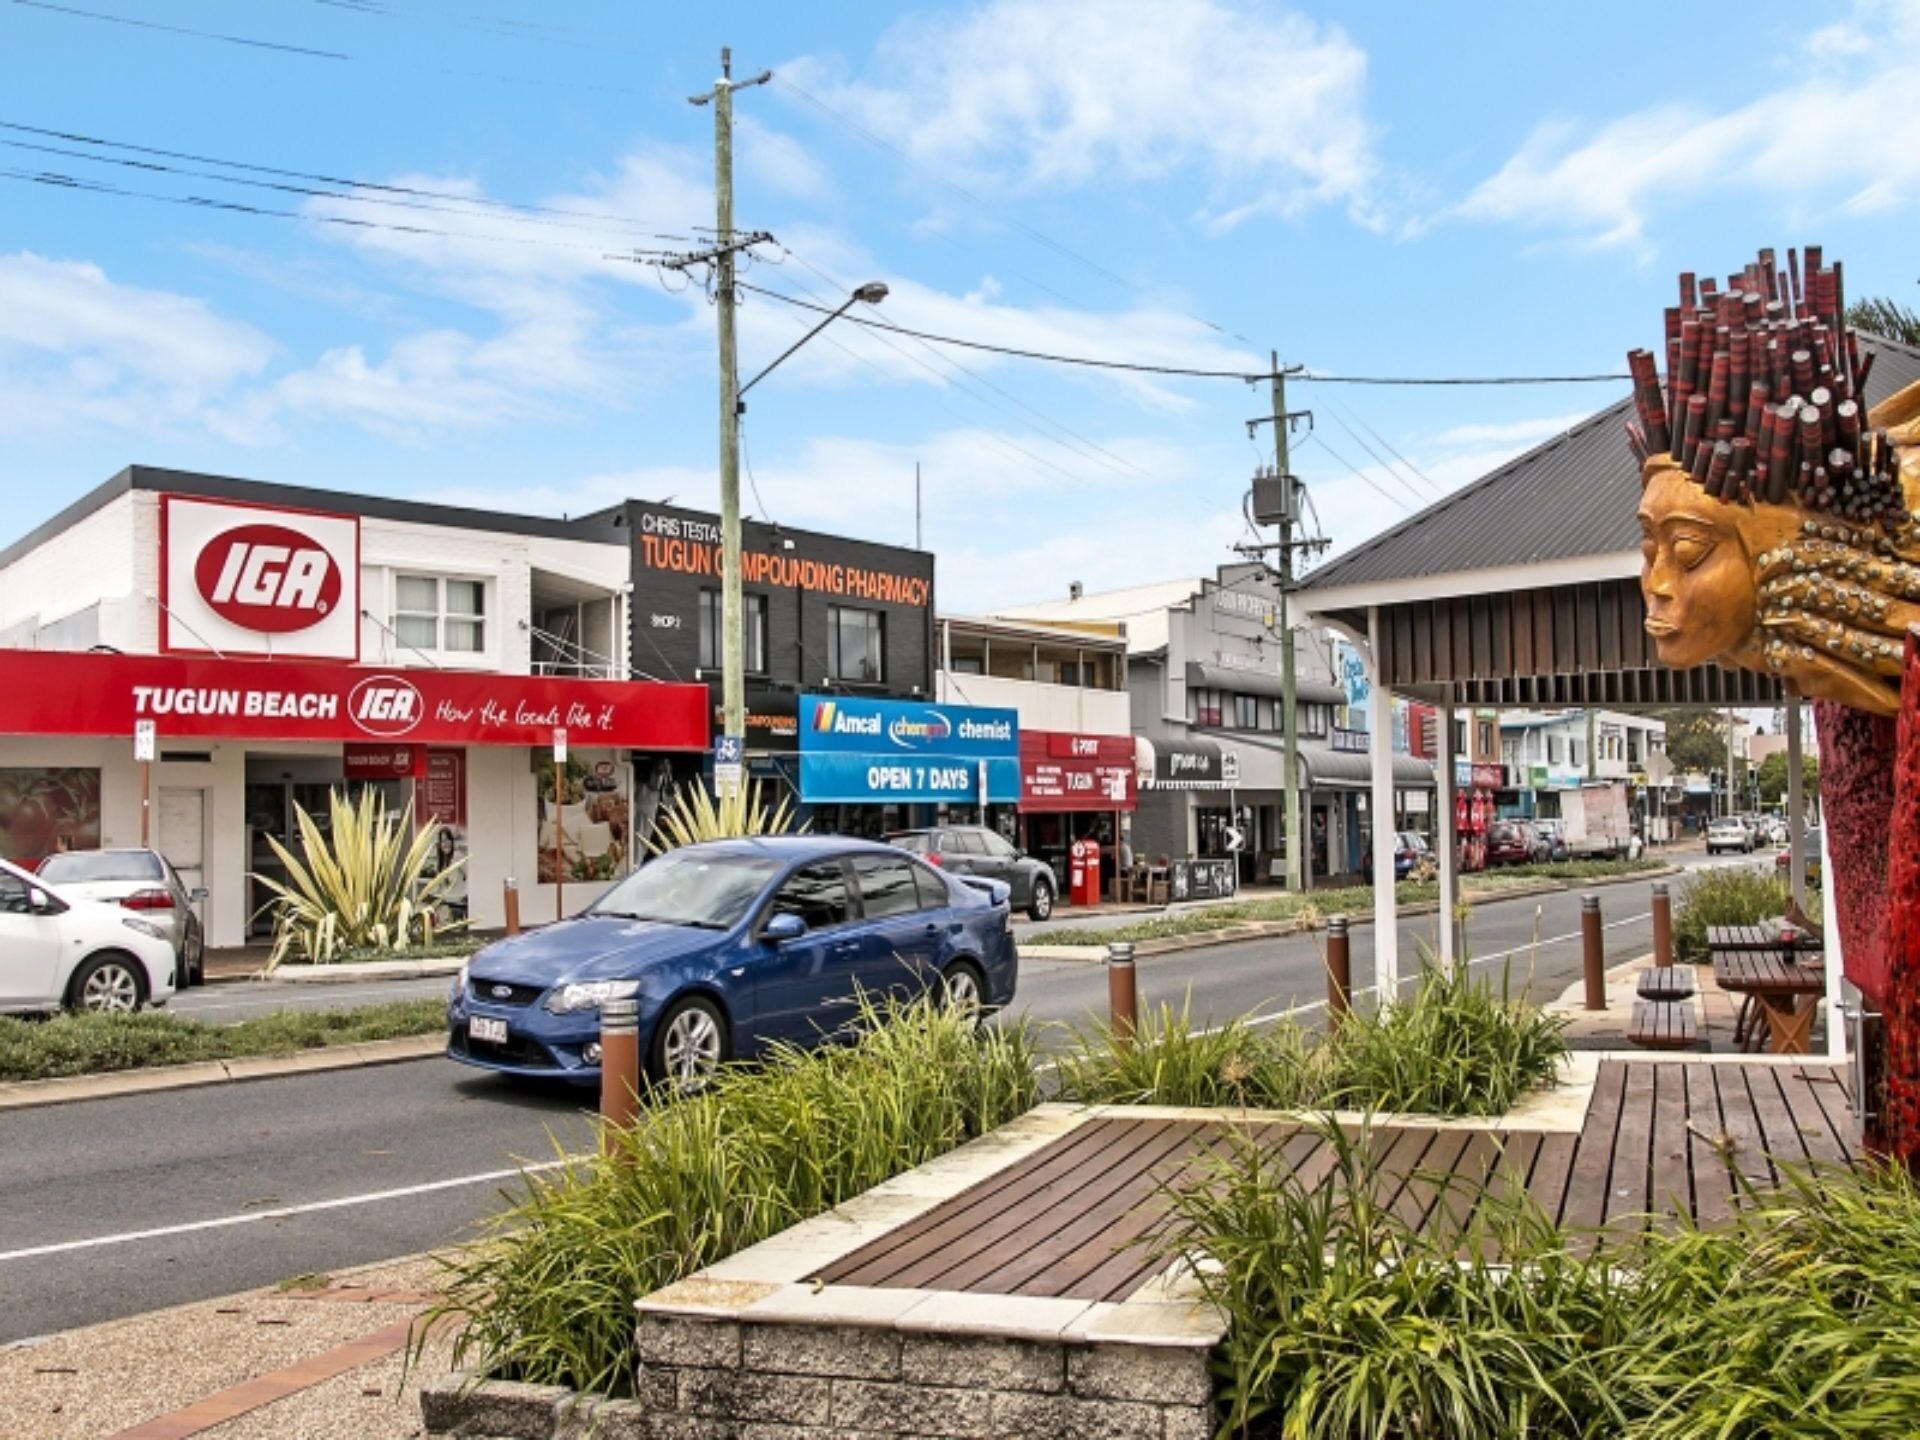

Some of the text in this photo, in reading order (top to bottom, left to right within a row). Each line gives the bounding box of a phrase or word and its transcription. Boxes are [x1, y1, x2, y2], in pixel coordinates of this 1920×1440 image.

[641, 512, 680, 537] CHRIS
[211, 542, 329, 610] IGA
[641, 535, 930, 606] TUGUN CMPOUNDING PHARMACY
[132, 686, 239, 715] TUGUN
[244, 692, 338, 719] BEACH
[357, 688, 414, 721] IGA
[435, 699, 473, 723] How
[480, 698, 508, 727] the
[835, 711, 881, 734] Amcal
[959, 718, 1011, 741] chemist
[868, 767, 910, 790] OPEN
[916, 769, 924, 789] 7
[930, 769, 968, 790] DAYS
